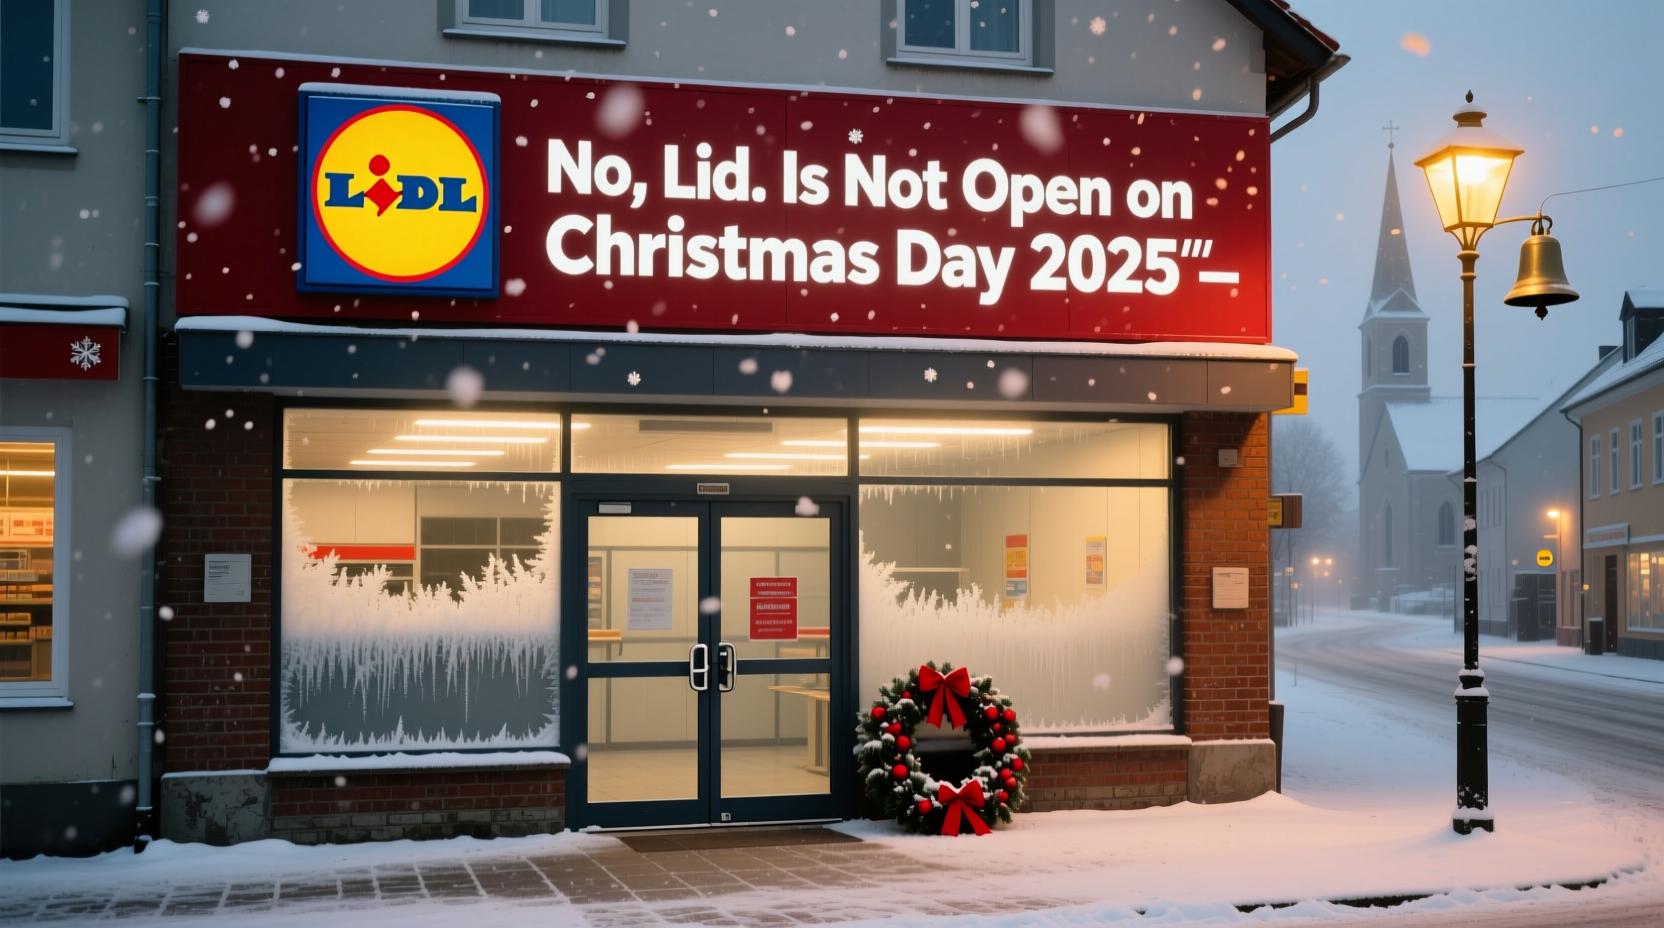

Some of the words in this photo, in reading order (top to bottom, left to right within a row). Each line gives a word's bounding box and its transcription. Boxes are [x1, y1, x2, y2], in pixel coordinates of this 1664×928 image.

[547, 138, 648, 209] No,
[664, 142, 767, 203] Lid.
[783, 150, 830, 206] Is
[844, 153, 948, 211] Not
[962, 157, 1112, 228] Open
[1126, 179, 1193, 220] on
[545, 213, 880, 285] Christmas
[896, 229, 1016, 306] Day
